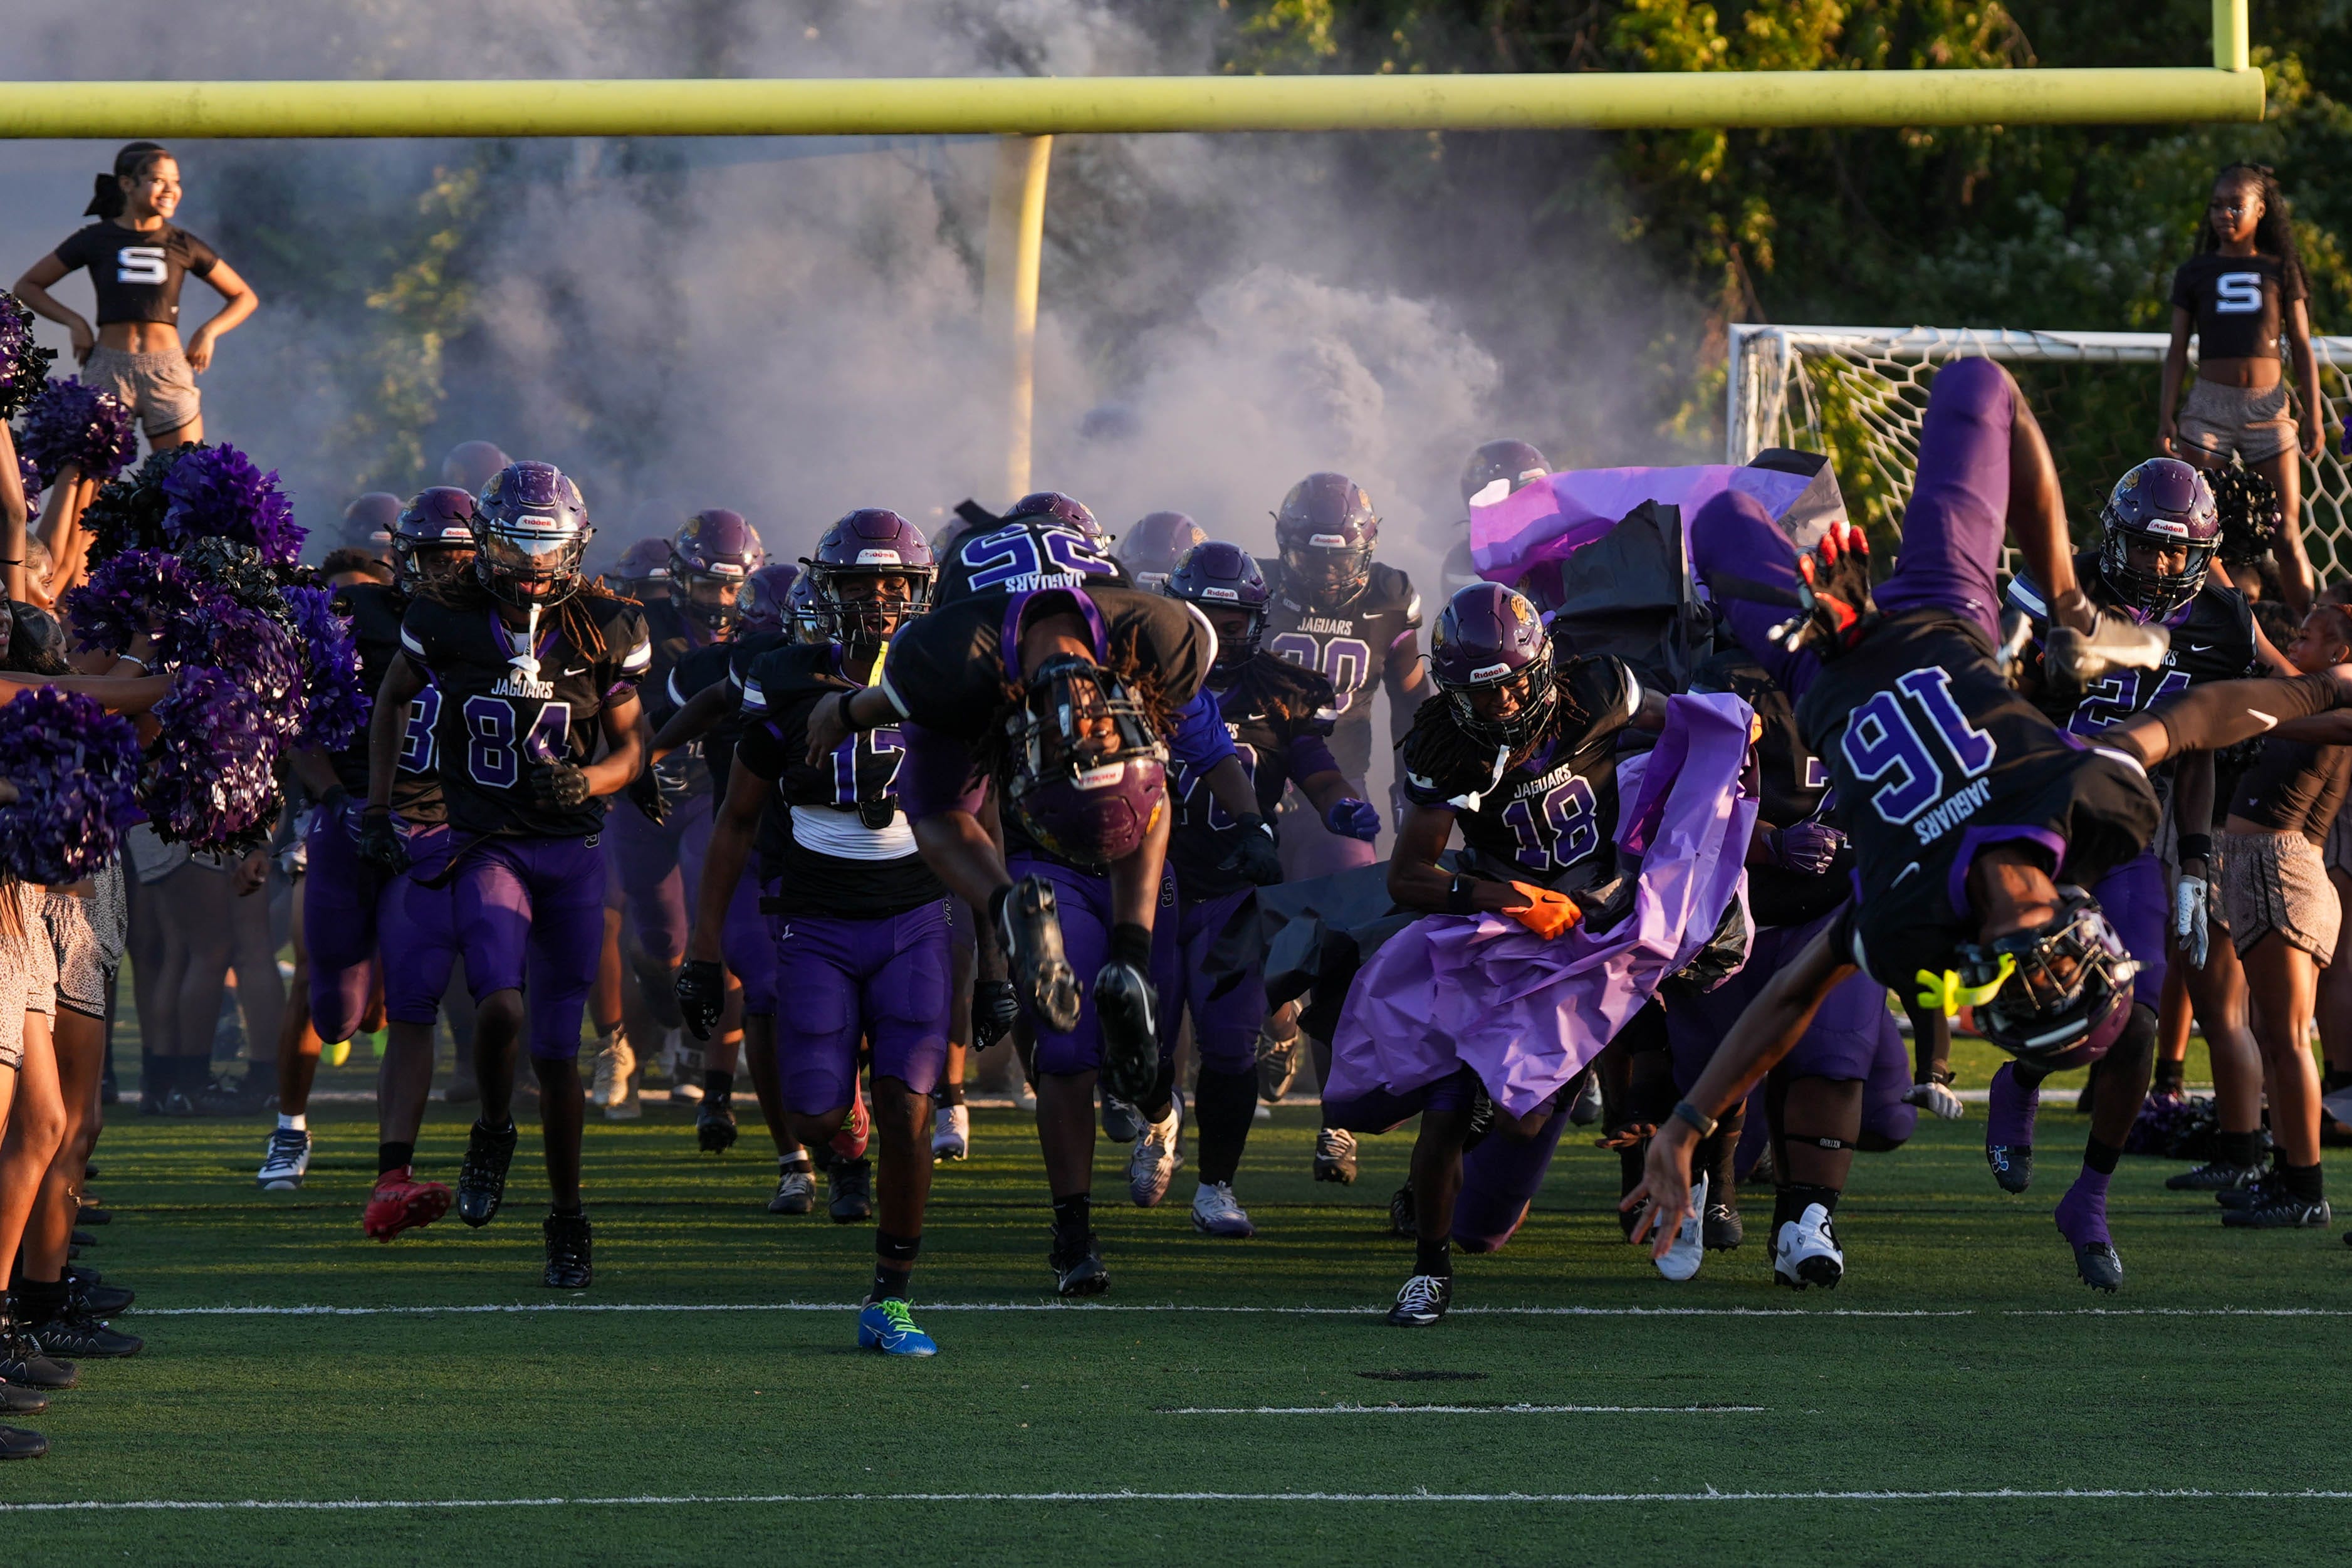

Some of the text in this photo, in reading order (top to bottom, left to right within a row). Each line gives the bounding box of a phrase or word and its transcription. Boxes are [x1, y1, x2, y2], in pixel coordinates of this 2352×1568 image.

[117, 246, 168, 285] S
[2215, 271, 2262, 313] S
[1005, 571, 1087, 592] JAGUARS
[1207, 589, 1235, 597] Riddell
[1297, 617, 1354, 635] JAGUARS
[491, 677, 554, 699] JAGUARS
[1474, 667, 1504, 679] Riddell
[463, 695, 572, 789] 84
[1841, 666, 1997, 825] 16
[1514, 763, 1572, 798] JAGUARS
[1502, 775, 1599, 872] 18
[1913, 776, 1992, 845] JAGUARS
[1161, 875, 1175, 907] S
